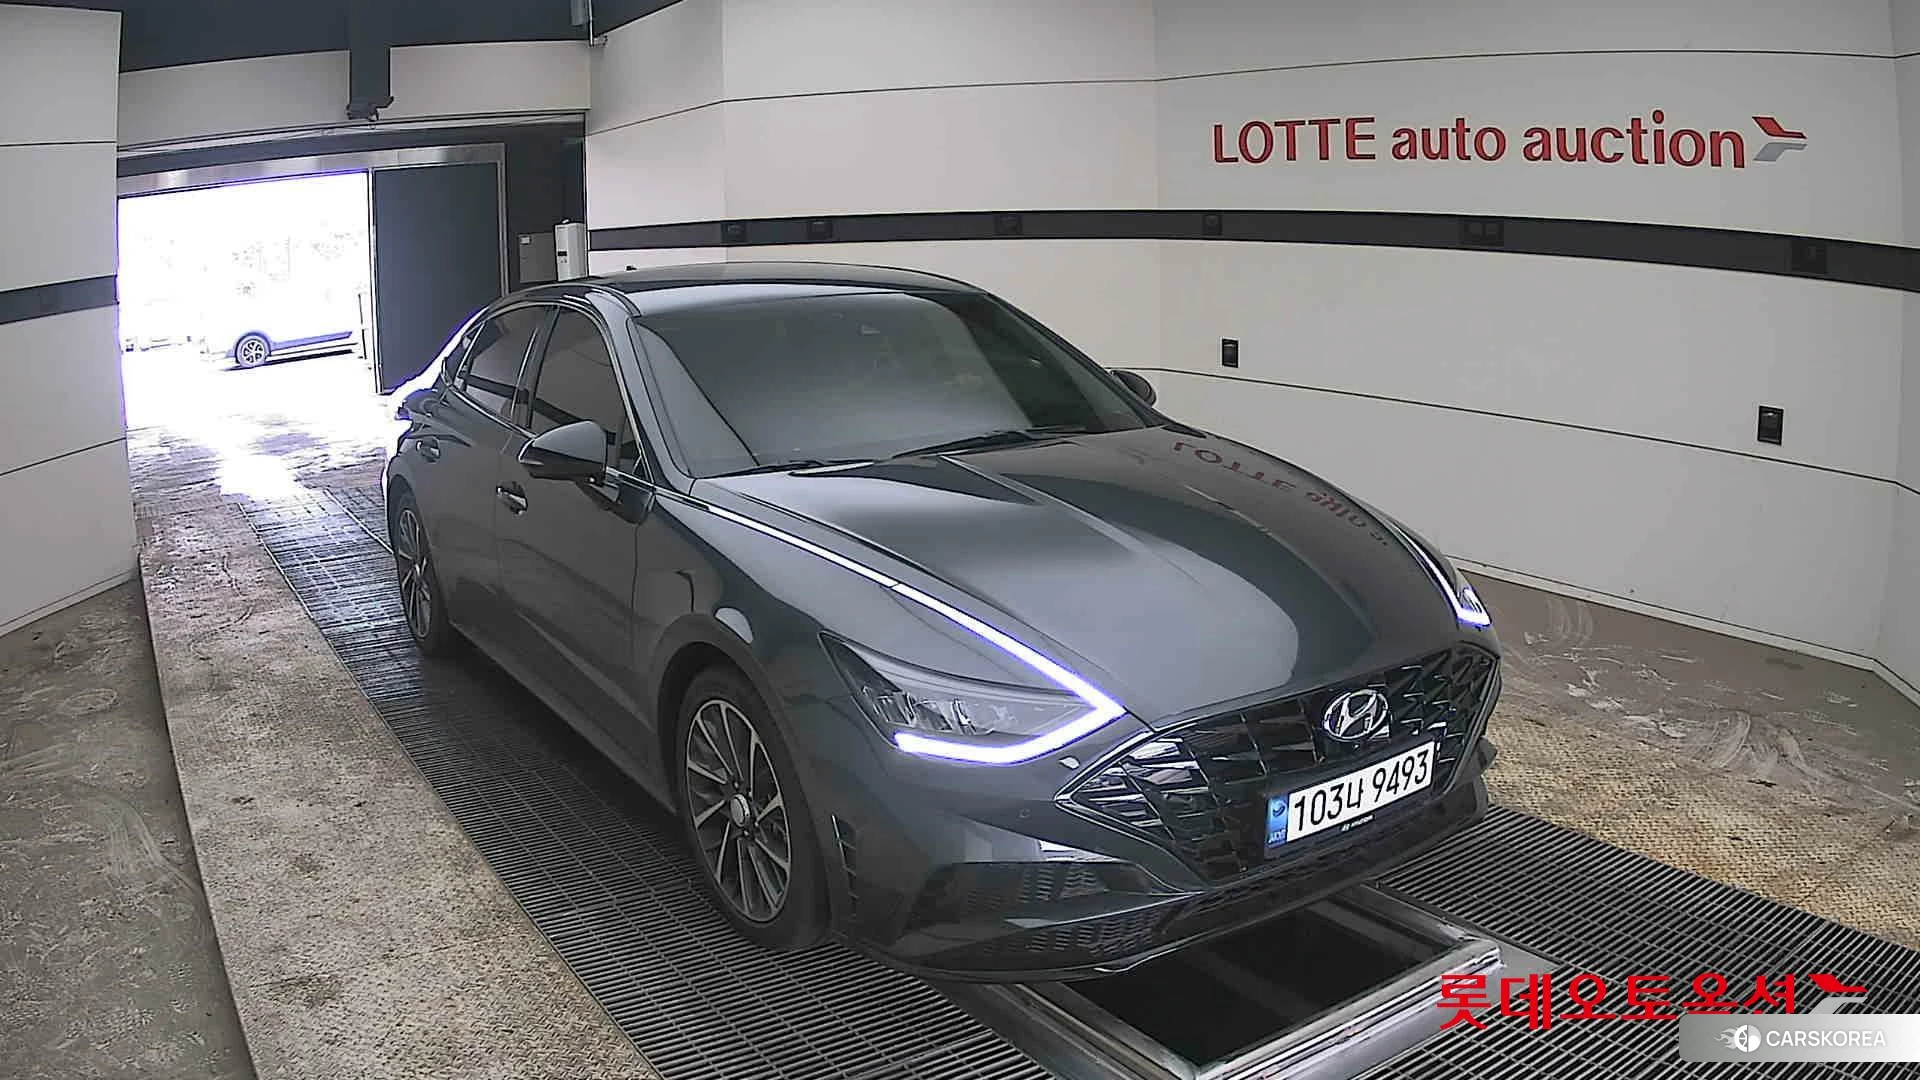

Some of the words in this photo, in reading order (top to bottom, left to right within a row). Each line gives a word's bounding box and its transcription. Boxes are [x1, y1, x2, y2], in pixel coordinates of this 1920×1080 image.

[1213, 117, 1376, 164] LOTTE
[1392, 118, 1506, 162] auto
[1523, 110, 1746, 168] auction
[1294, 777, 1364, 831] 103나
[1372, 750, 1430, 803] 9493
